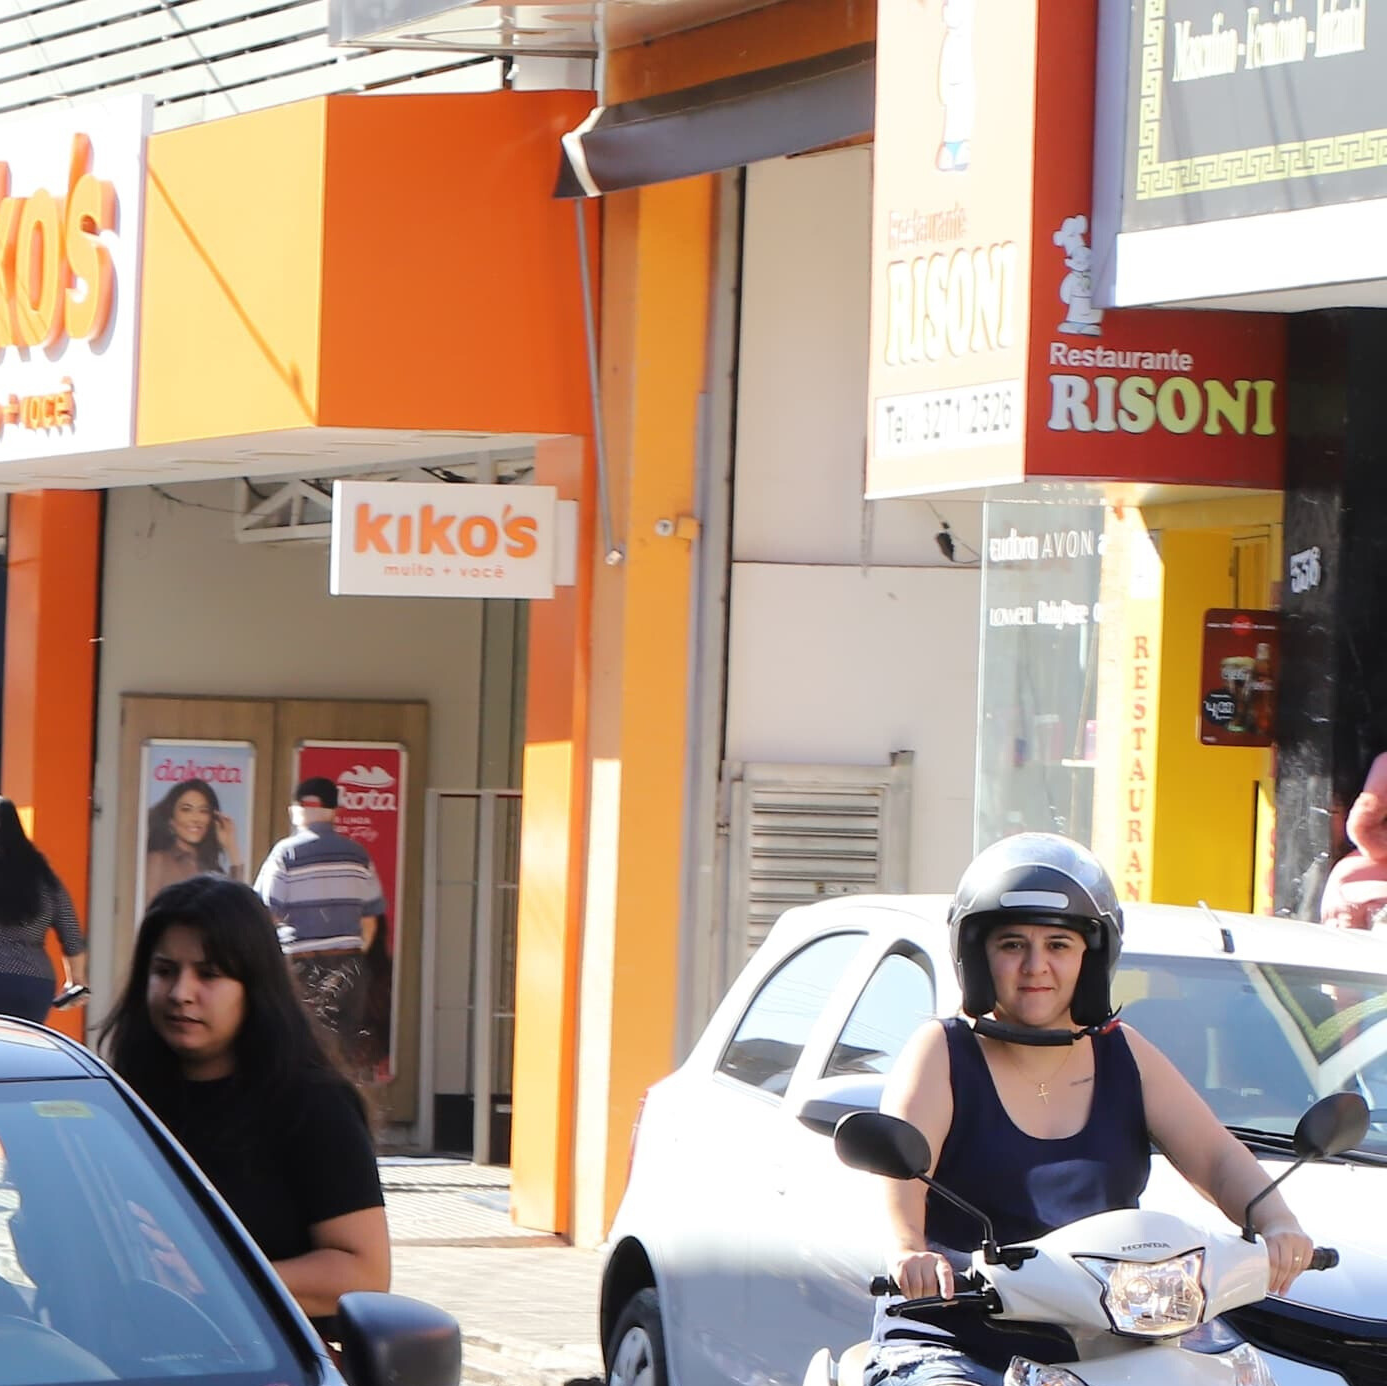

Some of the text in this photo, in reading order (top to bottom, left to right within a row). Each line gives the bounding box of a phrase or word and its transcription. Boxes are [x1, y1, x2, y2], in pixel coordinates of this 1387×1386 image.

[885, 240, 1017, 366] RISONI
[1050, 342, 1194, 371] Restaurante
[1048, 374, 1276, 435] RISONI
[1041, 530, 1094, 558] AVON
[384, 563, 435, 577] muito
[460, 563, 505, 578] você
[155, 759, 242, 783] dakota
[1125, 635, 1149, 902] RESTAURAN
[337, 785, 396, 811] kota
[1120, 1242, 1171, 1251] HONDA
